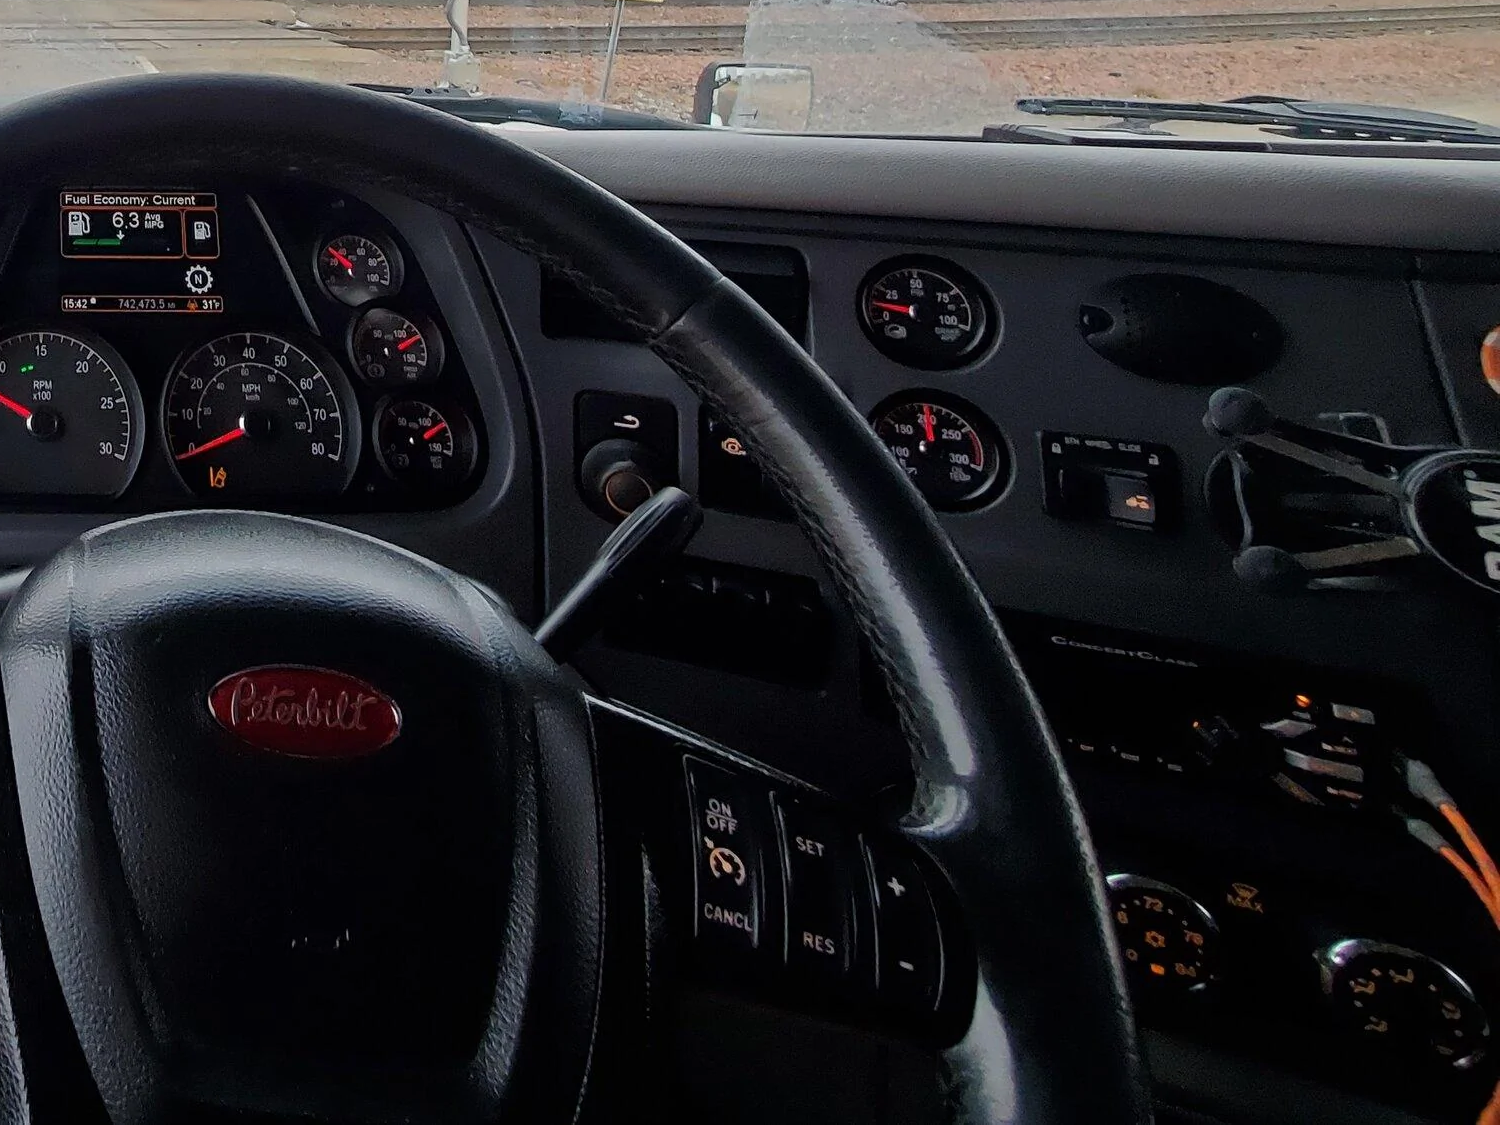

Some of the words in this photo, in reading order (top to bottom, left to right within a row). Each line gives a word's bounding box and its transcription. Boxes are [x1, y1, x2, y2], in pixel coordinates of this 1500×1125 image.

[65, 194, 90, 205] Fuel
[93, 194, 150, 207] Economy:
[152, 194, 196, 205] Current
[112, 211, 140, 229] 6.3
[144, 213, 161, 222] Avg
[144, 220, 165, 229] MPG
[356, 247, 366, 256] 60
[368, 257, 378, 267] 80
[194, 274, 203, 285] N
[366, 273, 379, 282] 100
[910, 278, 923, 289] 50
[885, 290, 898, 300] 25
[936, 292, 950, 303] 75
[63, 299, 88, 309] 15:42
[118, 299, 166, 310] 742,473.5
[883, 311, 890, 321] 0
[939, 315, 958, 325] 100
[393, 329, 407, 338] 100
[35, 345, 47, 357] 15
[242, 348, 255, 359] 40
[213, 355, 226, 367] 30
[274, 355, 287, 367] 50
[403, 353, 416, 363] 150
[76, 362, 89, 373] 20
[33, 380, 53, 391] RPM
[190, 378, 203, 390] 20
[241, 383, 261, 394] MPH
[300, 378, 313, 390] 60
[32, 391, 52, 401] x100
[101, 397, 114, 409] 25
[182, 409, 193, 420] 10
[313, 409, 326, 420] 70
[418, 417, 432, 426] 100
[894, 423, 914, 435] 150
[941, 428, 962, 441] 250
[99, 443, 113, 455] 30
[311, 443, 325, 455] 80
[428, 443, 442, 452] 150
[949, 453, 970, 465] 300
[231, 677, 379, 731] Peterbilt
[708, 798, 732, 818] ON
[706, 815, 737, 835] OFF
[795, 836, 825, 857] SET
[803, 931, 835, 955] RES
